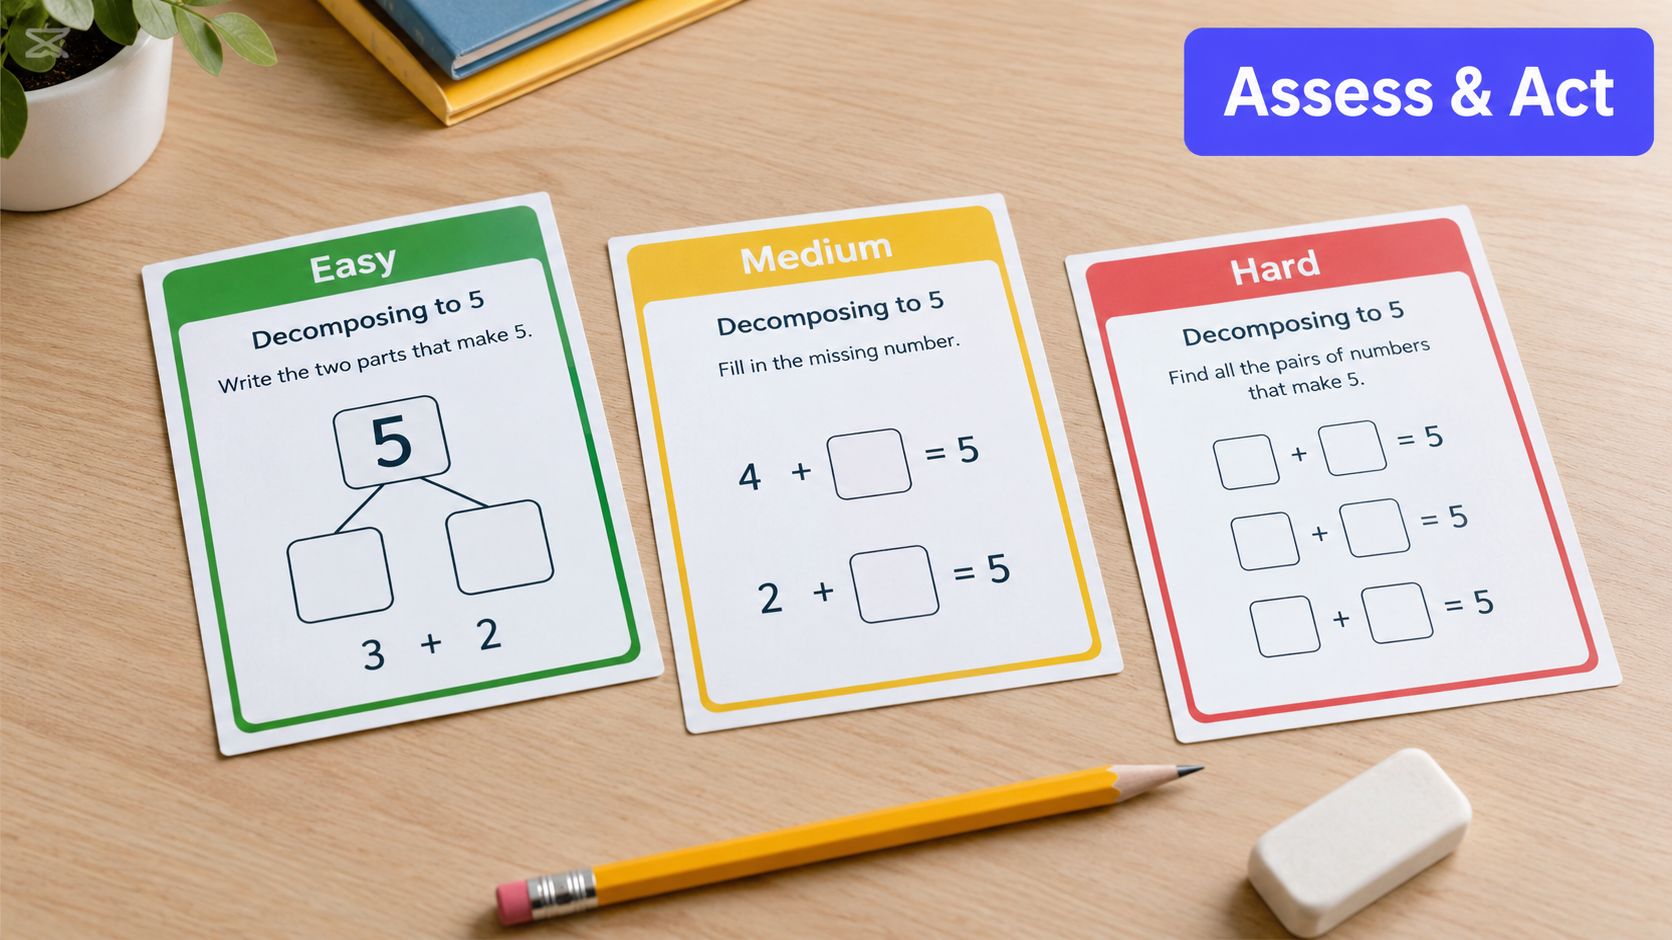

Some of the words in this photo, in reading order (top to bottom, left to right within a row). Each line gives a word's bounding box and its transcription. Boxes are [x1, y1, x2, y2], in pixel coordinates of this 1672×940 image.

[310, 249, 396, 283] Easy
[741, 238, 893, 274] Medium
[1231, 249, 1320, 285] Hard
[252, 305, 427, 349] Decomposing
[434, 299, 461, 314] to
[469, 290, 484, 308] 5
[718, 301, 888, 336] Decomposing
[895, 297, 921, 313] to
[929, 291, 943, 309] 5
[1183, 312, 1350, 346] Decomposing
[1356, 307, 1381, 322] to
[1389, 301, 1404, 318] 5
[218, 375, 271, 393] Write
[277, 367, 309, 382] the
[315, 361, 351, 376] two
[358, 350, 406, 373] parts
[412, 339, 451, 358] that
[457, 330, 508, 349] make
[515, 324, 532, 338] 5.
[719, 360, 744, 377] Fill
[750, 359, 768, 373] in
[773, 355, 802, 370] the
[809, 347, 878, 365] missing
[884, 335, 961, 355] number.
[1169, 366, 1208, 384] Find
[1215, 363, 1235, 379] all
[1240, 360, 1270, 375] the
[1276, 354, 1320, 374] pairs
[1327, 348, 1343, 363] of
[1350, 341, 1430, 360] numbers
[1248, 383, 1287, 399] that
[1292, 376, 1341, 394] make
[1348, 372, 1364, 386] 5.
[373, 415, 411, 467] 5
[1292, 447, 1306, 461] +
[1398, 435, 1415, 445] =
[1425, 425, 1443, 447] 5
[739, 463, 761, 490] 4
[792, 463, 811, 480] +
[926, 448, 945, 460] =
[958, 436, 978, 463] 5
[1312, 527, 1327, 541] +
[1421, 515, 1438, 525] =
[1449, 505, 1467, 528] 5
[759, 583, 782, 614] 2
[814, 582, 833, 601] +
[954, 567, 975, 580] =
[988, 554, 1009, 583] 5
[1333, 611, 1349, 627] +
[1445, 600, 1463, 611] =
[1474, 590, 1493, 614] 5
[362, 640, 384, 670] 3
[421, 634, 441, 653] +
[477, 619, 501, 650] 2
